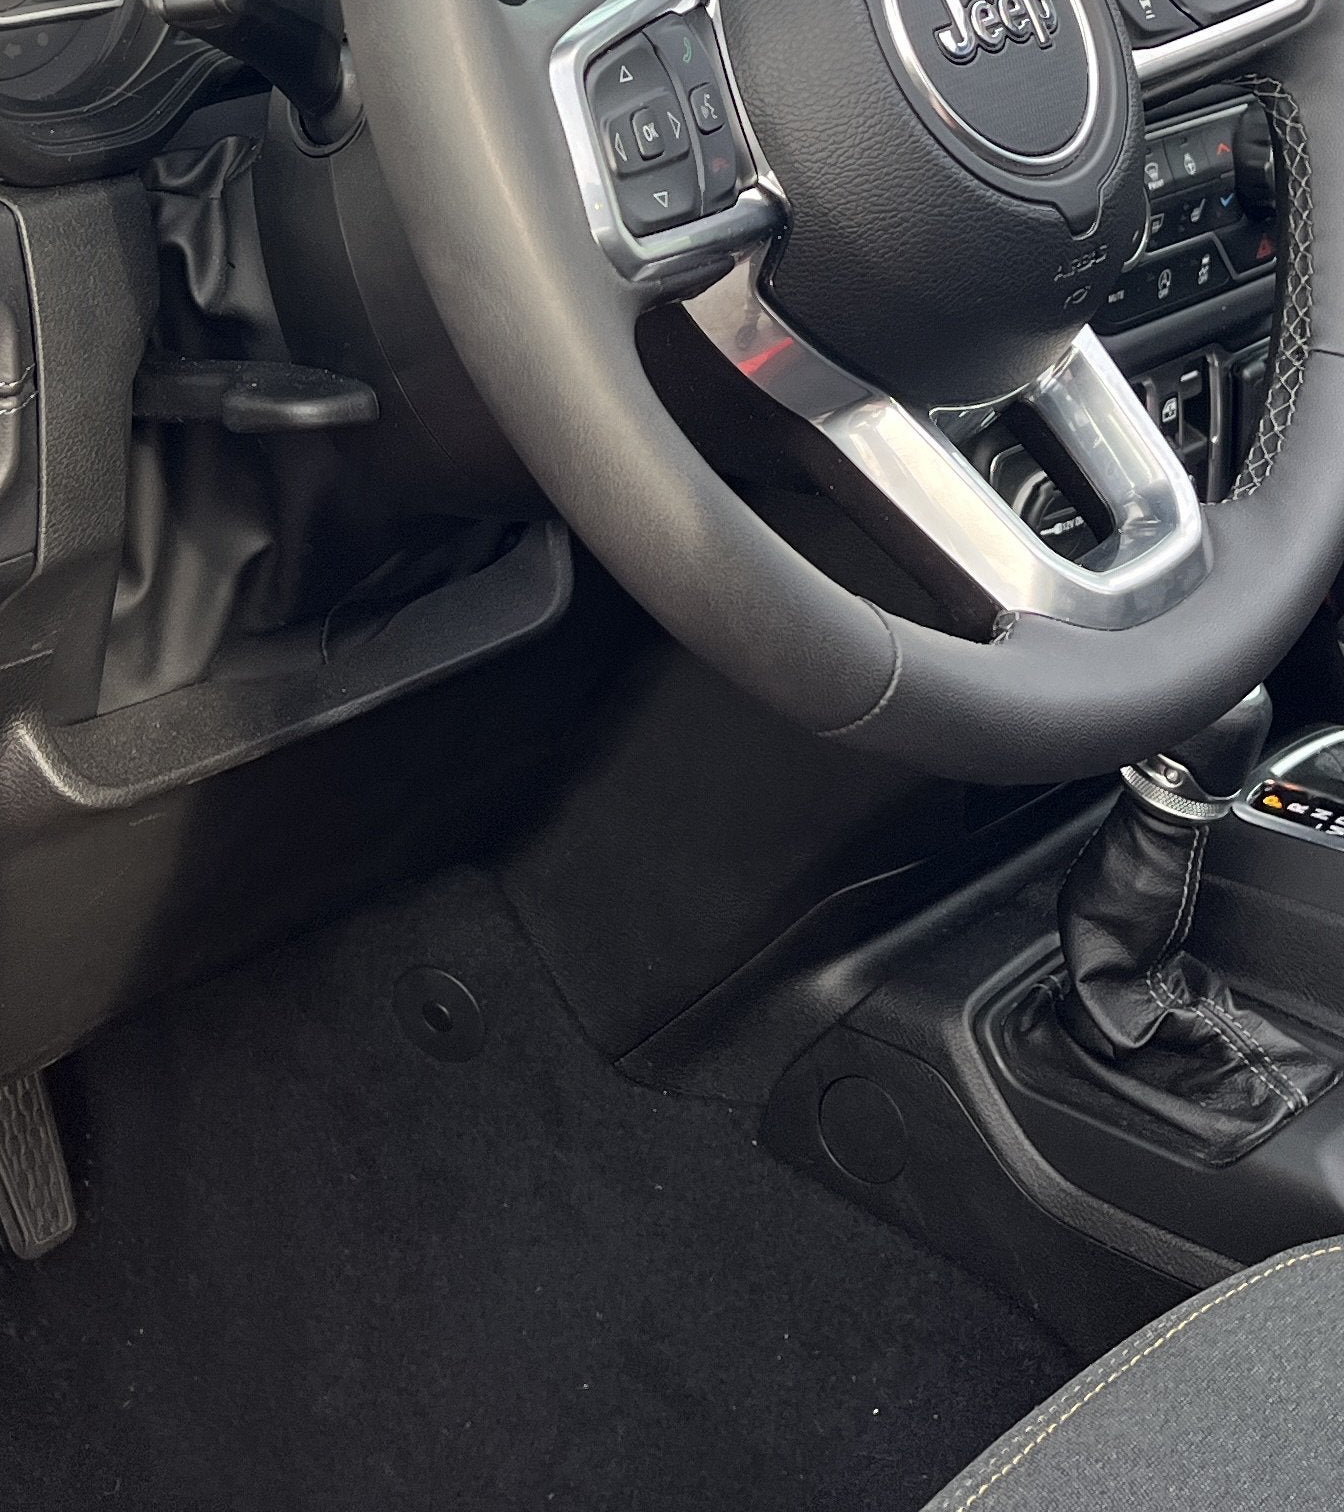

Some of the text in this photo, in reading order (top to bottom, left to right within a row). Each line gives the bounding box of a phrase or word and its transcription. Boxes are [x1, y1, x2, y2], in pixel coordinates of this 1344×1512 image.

[642, 122, 660, 142] OK
[1287, 802, 1309, 815] R
[1310, 808, 1334, 821] N
